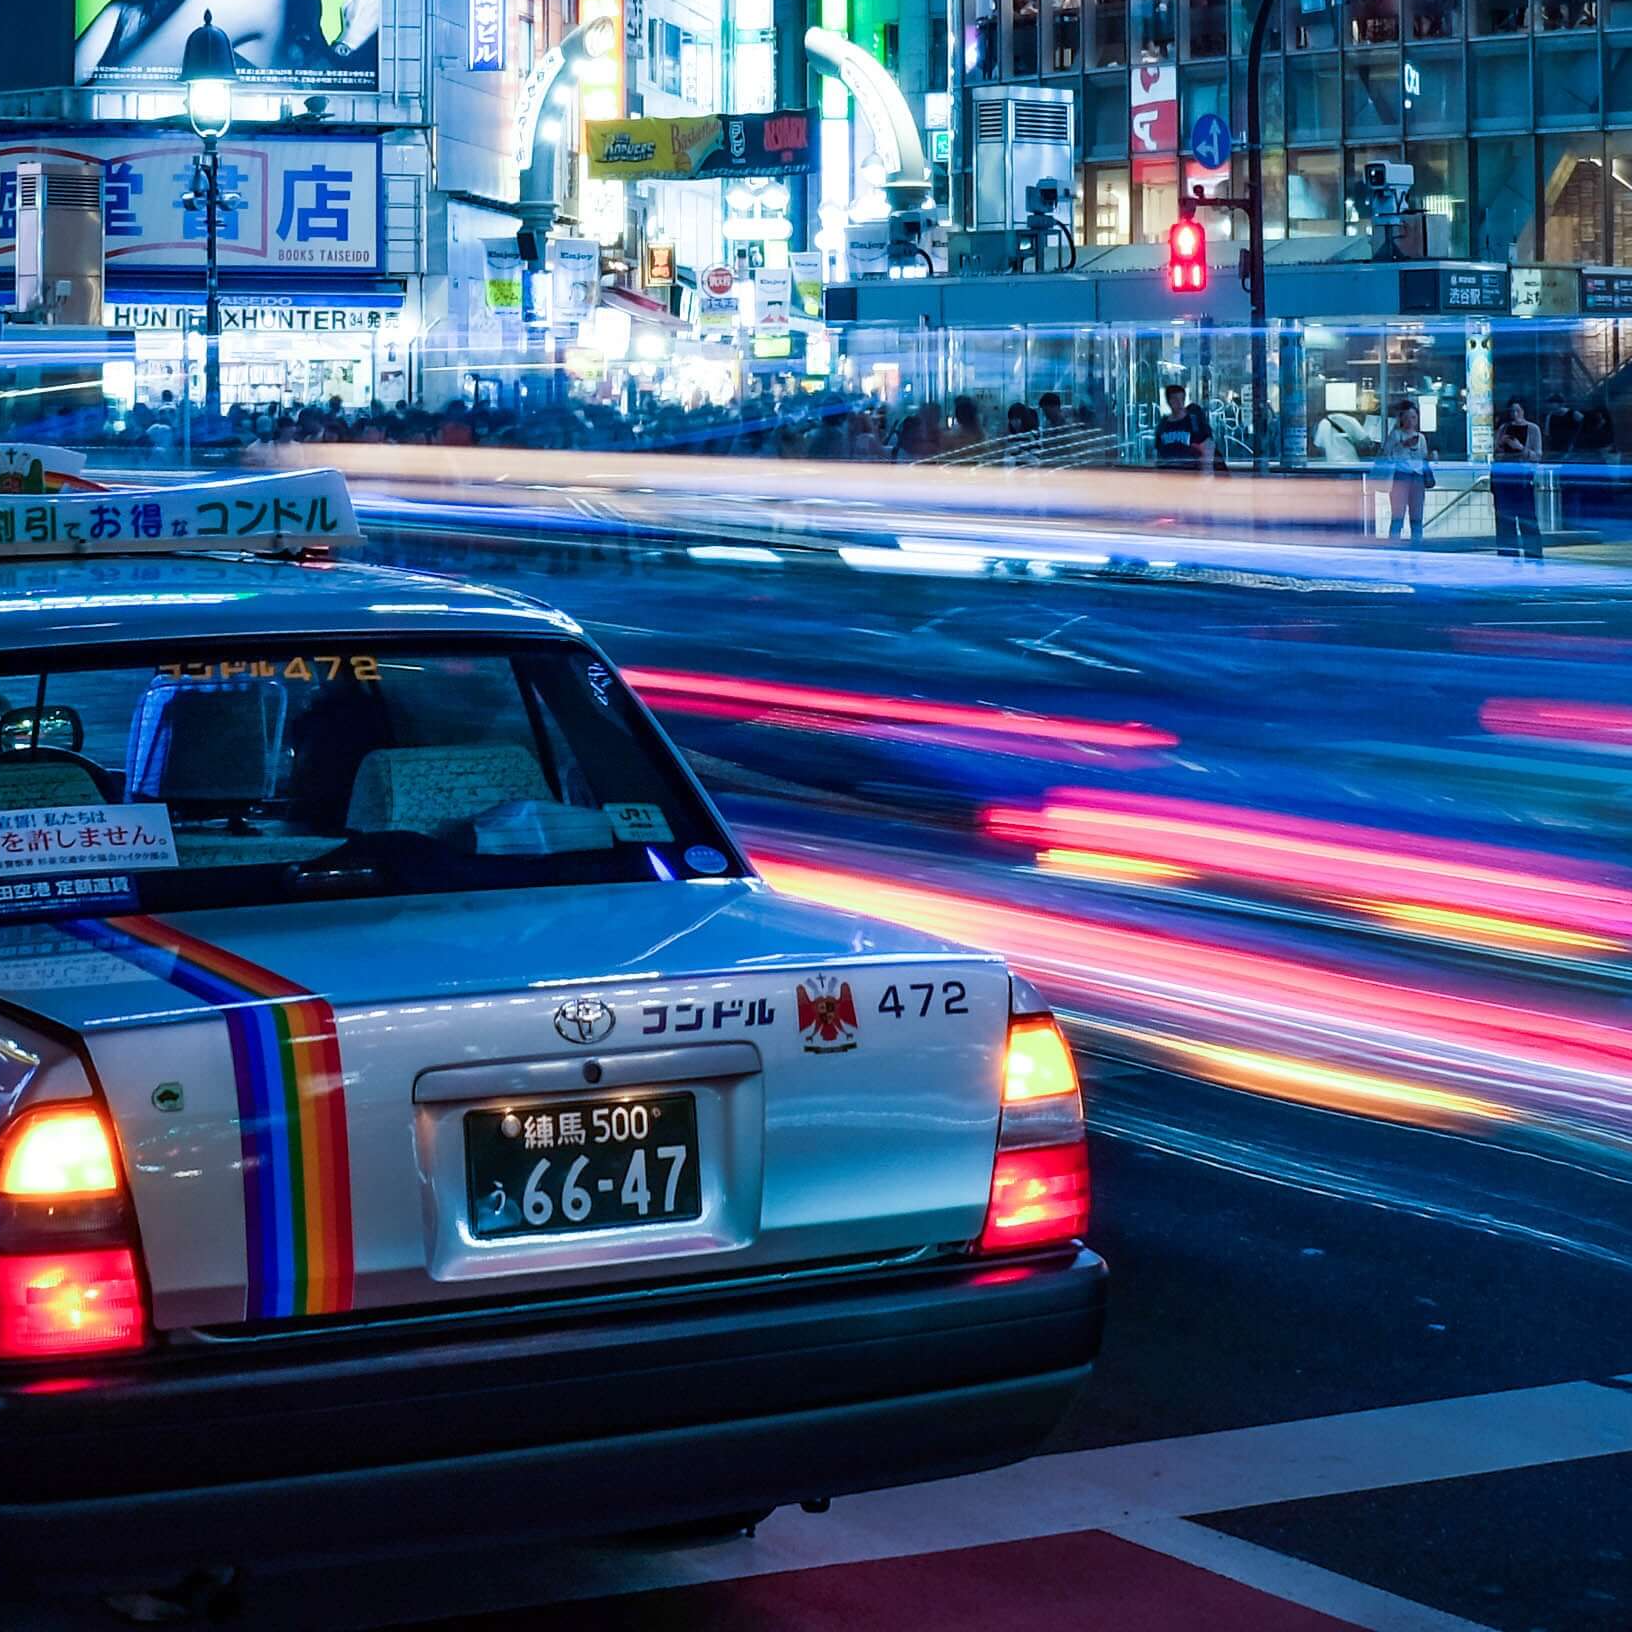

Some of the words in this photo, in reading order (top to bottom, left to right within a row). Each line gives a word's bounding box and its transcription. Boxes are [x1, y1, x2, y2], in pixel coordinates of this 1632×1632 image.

[278, 249, 314, 262] BOOKS
[319, 249, 370, 263] TAISEIDO
[283, 655, 381, 682] 472
[43, 810, 107, 827] 私たちは
[55, 874, 131, 896] 定額運賃
[642, 997, 776, 1035] コンドル
[877, 980, 970, 1020] 472
[522, 1109, 587, 1152] 練馬
[593, 1104, 650, 1144] 500
[522, 1144, 689, 1227] 66-47
